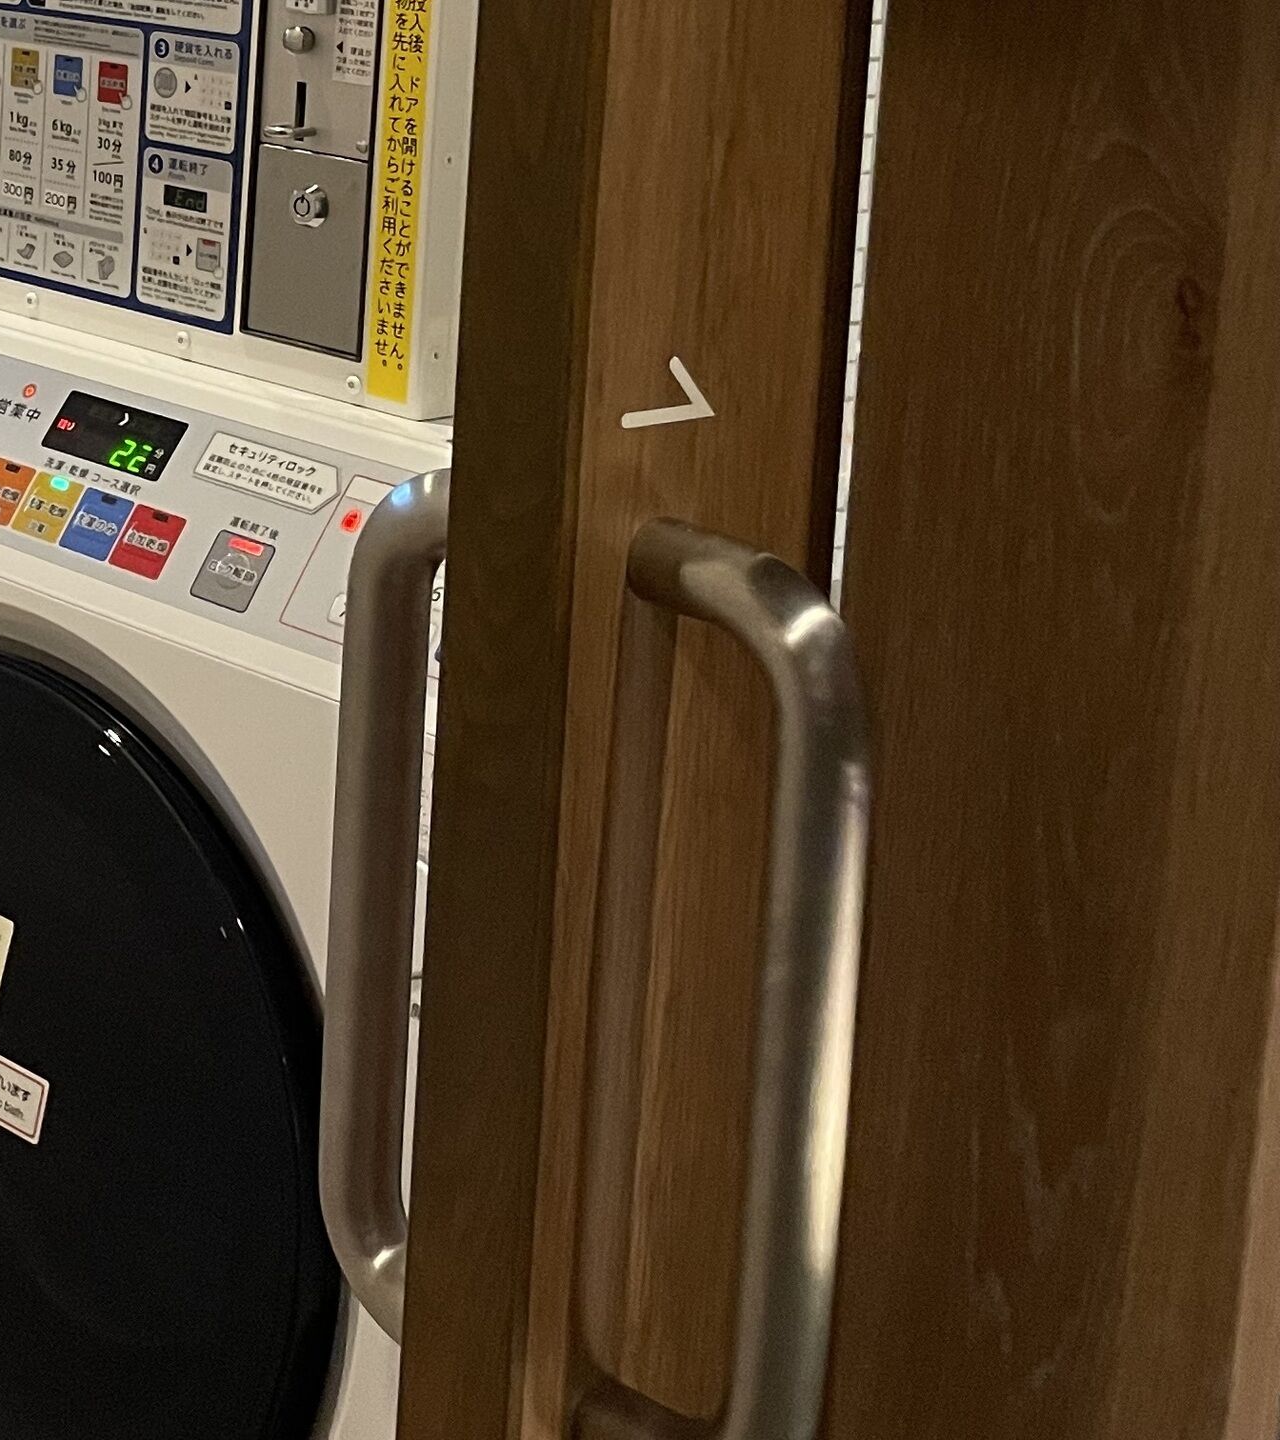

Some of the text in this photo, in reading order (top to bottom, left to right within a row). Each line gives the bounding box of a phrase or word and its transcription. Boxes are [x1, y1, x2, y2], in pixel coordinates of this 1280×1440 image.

[175, 41, 233, 60] 硬貨を入れる
[97, 136, 122, 154] 30分
[8, 149, 33, 166] 80分
[51, 157, 77, 175] 35分
[167, 158, 208, 176] 運転終了
[93, 170, 124, 189] 100円
[3, 182, 34, 201] 300円
[45, 191, 77, 210] 200円
[154, 447, 165, 459] 分
[229, 443, 316, 477] セキュリティロック
[91, 473, 142, 496] コース選択
[229, 516, 280, 541] 運転終了後
